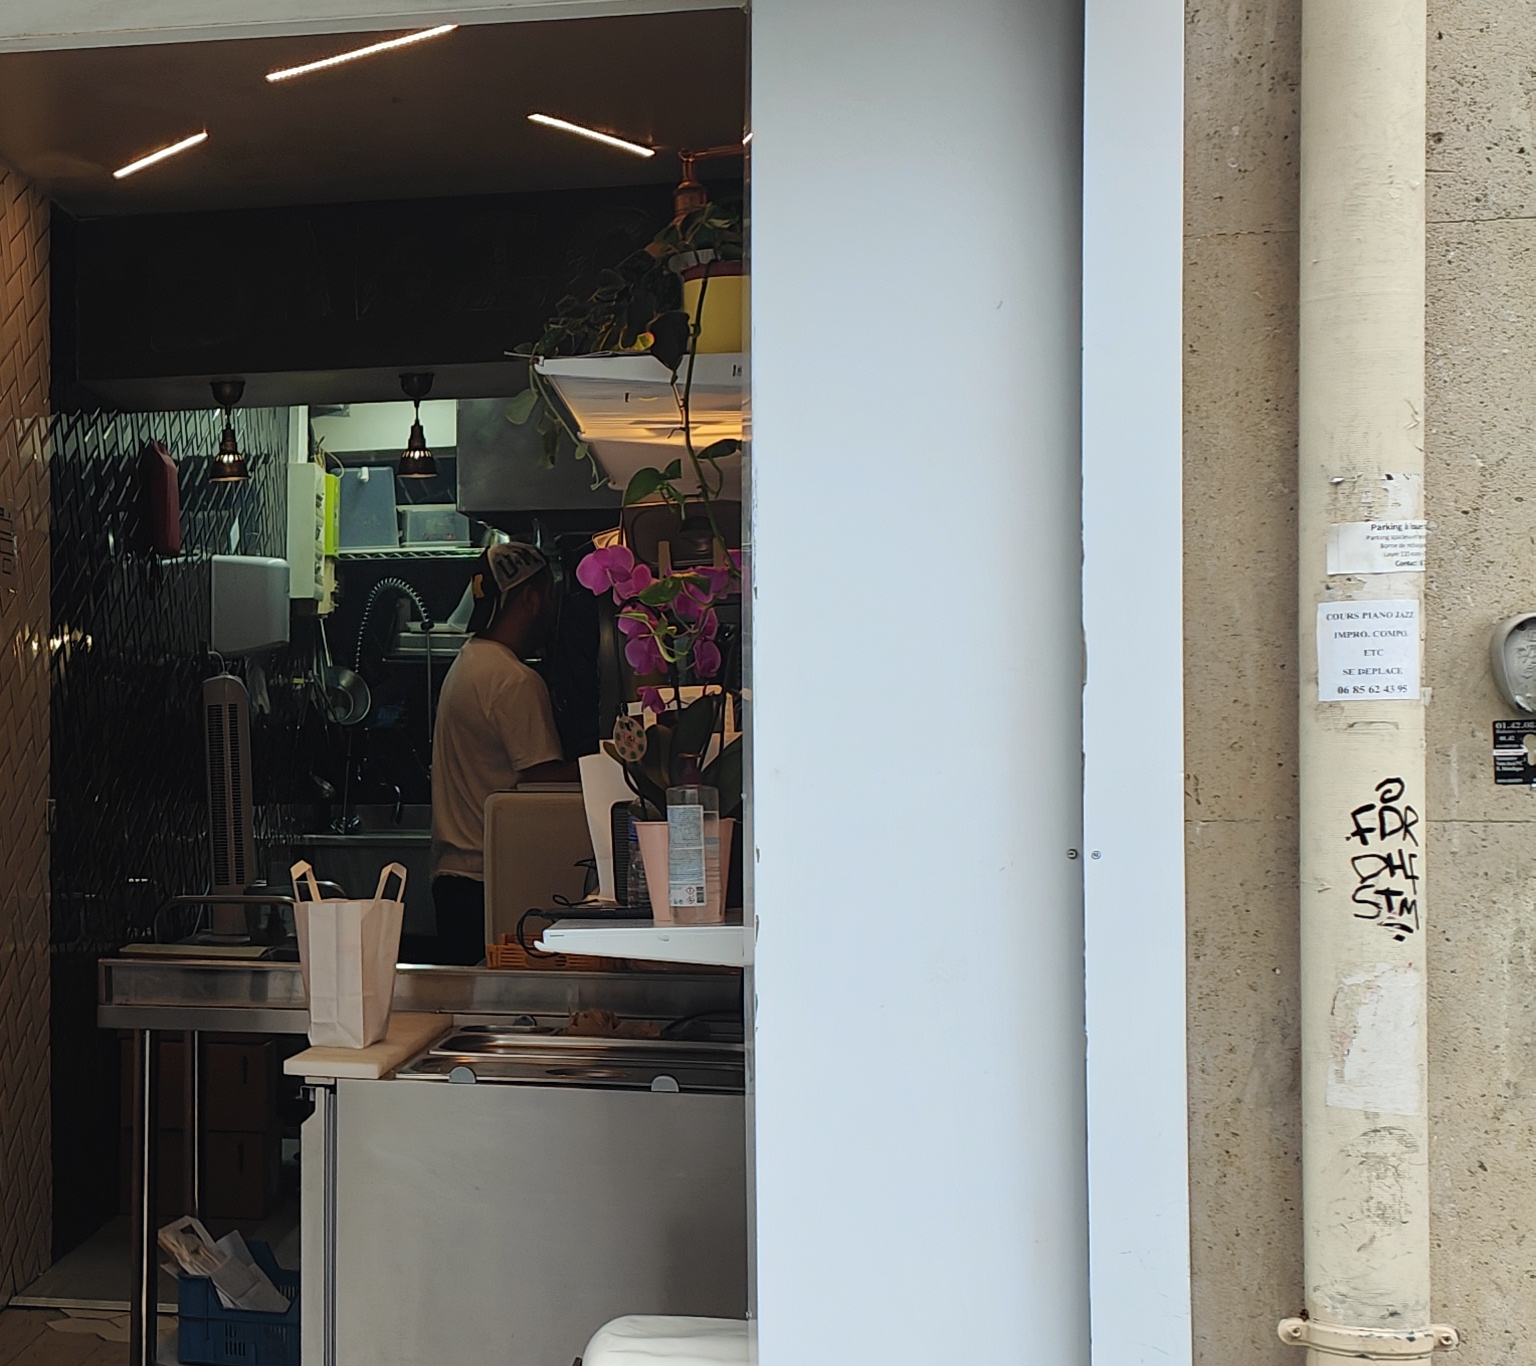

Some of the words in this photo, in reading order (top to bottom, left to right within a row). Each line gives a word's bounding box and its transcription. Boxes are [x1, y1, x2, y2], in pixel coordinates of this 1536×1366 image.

[1371, 523, 1403, 531] Parking
[1326, 613, 1359, 621] COURS
[1337, 686, 1349, 694] 06
